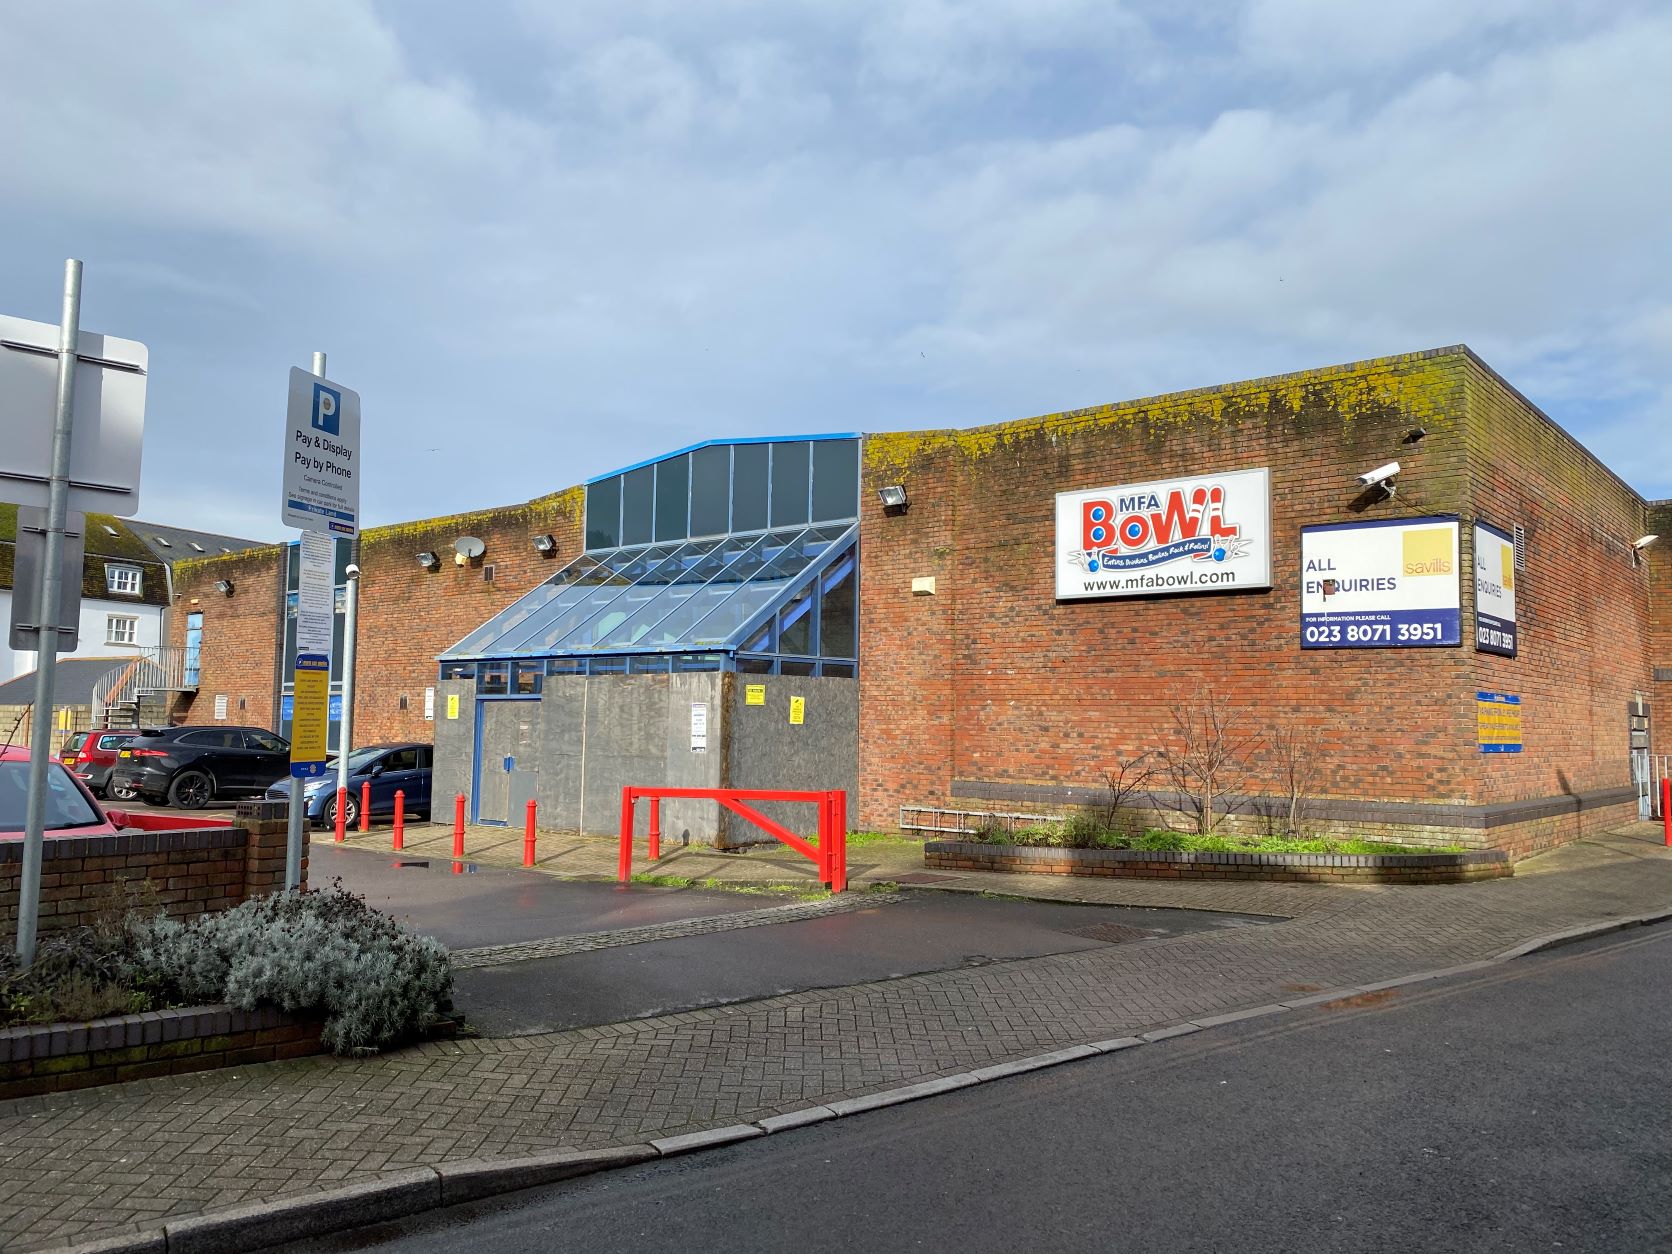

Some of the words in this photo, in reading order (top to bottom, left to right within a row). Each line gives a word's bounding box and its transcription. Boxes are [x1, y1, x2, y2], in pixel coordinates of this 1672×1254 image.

[295, 429, 313, 448] Pay
[314, 436, 321, 449] &
[322, 438, 353, 461] Display
[294, 451, 312, 470] Pay
[313, 456, 325, 473] by
[325, 460, 352, 479] Phone
[303, 474, 321, 485] Camera
[321, 479, 343, 491] Controlled
[1119, 494, 1161, 513] MFA
[1305, 558, 1337, 572] ALL
[1404, 558, 1451, 574] savills
[1083, 570, 1236, 591] www.mfabowl.com
[1306, 625, 1341, 642] 023
[1347, 624, 1391, 642] 8071
[1397, 622, 1442, 641] 3951
[1478, 626, 1490, 645] 023
